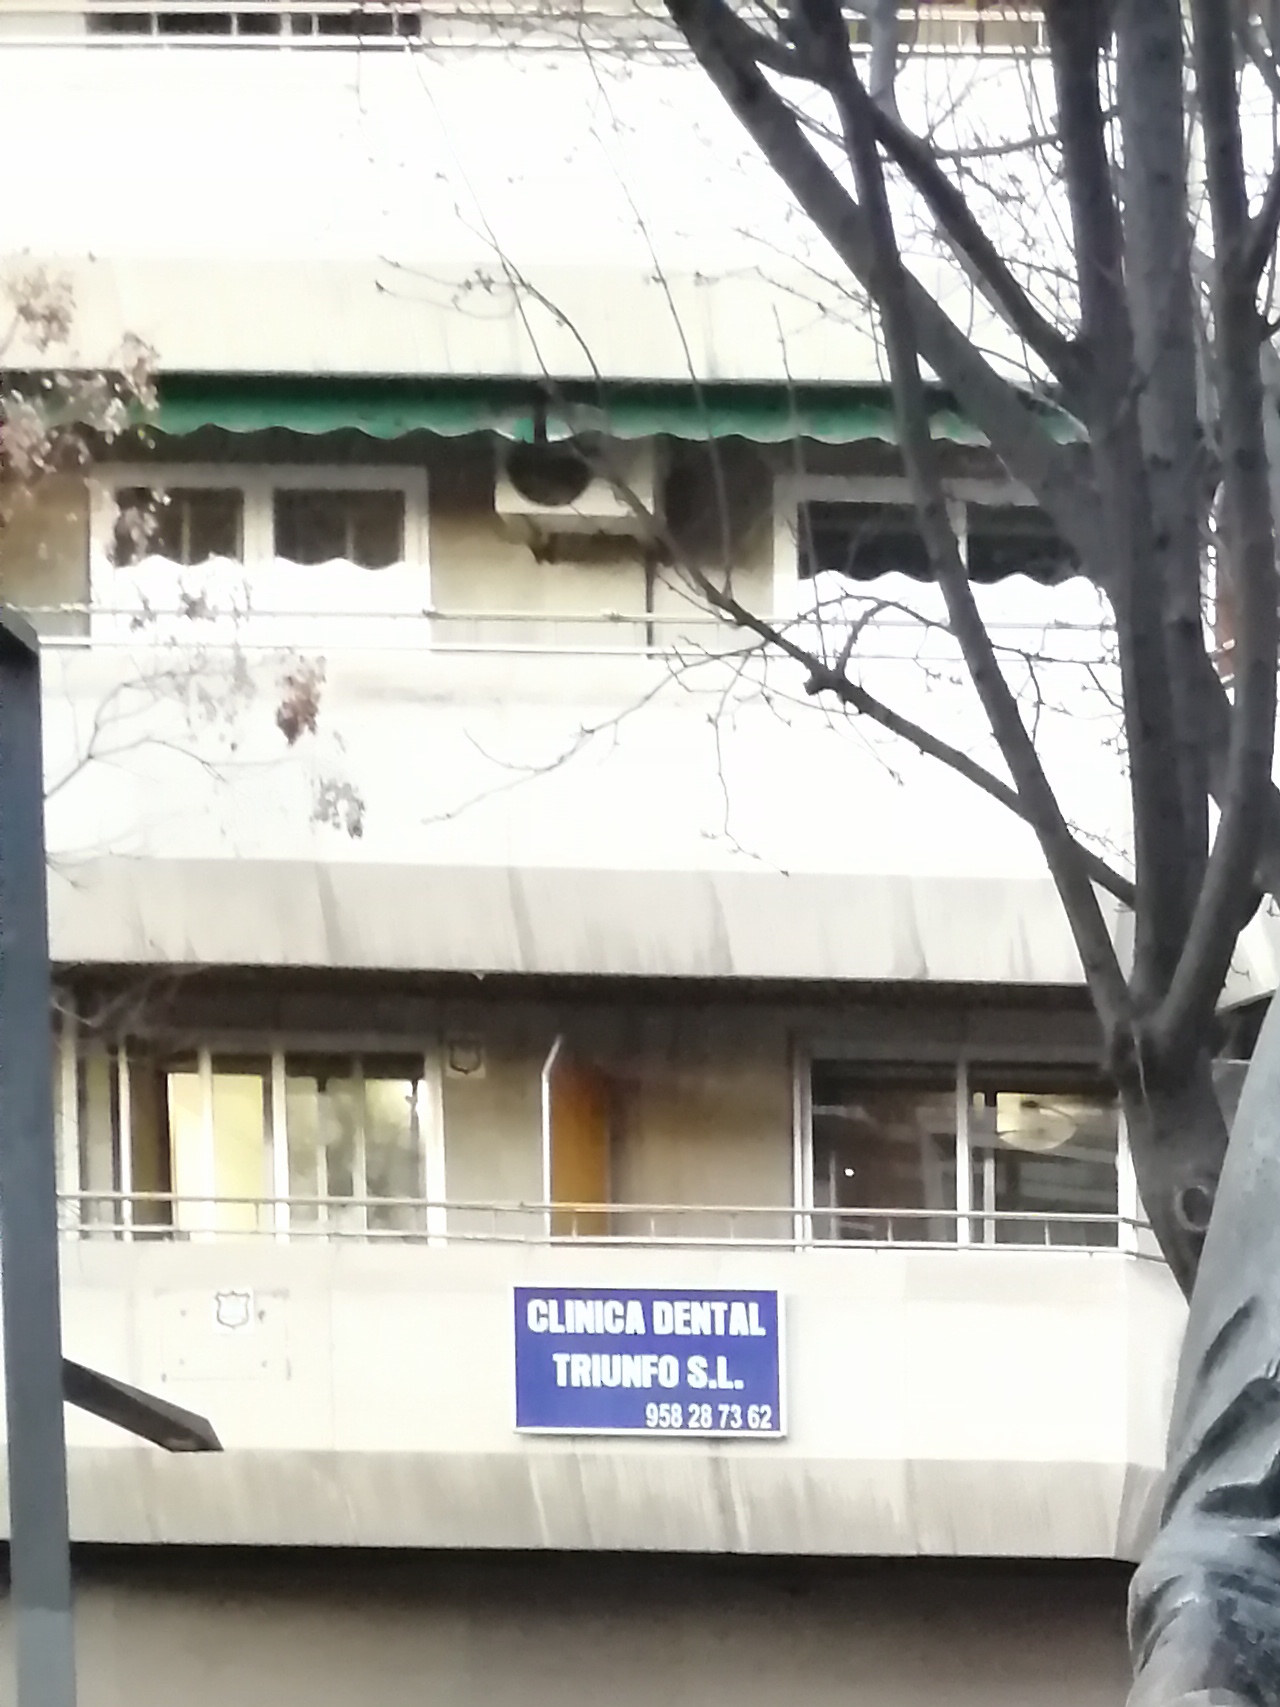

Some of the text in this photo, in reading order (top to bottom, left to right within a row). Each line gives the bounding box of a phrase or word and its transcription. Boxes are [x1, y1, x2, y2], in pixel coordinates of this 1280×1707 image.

[527, 1299, 766, 1336] CLINICA DENTAL
[552, 1353, 744, 1390] TRIUNFO S.L.
[645, 1402, 772, 1430] 958 28 73 62
